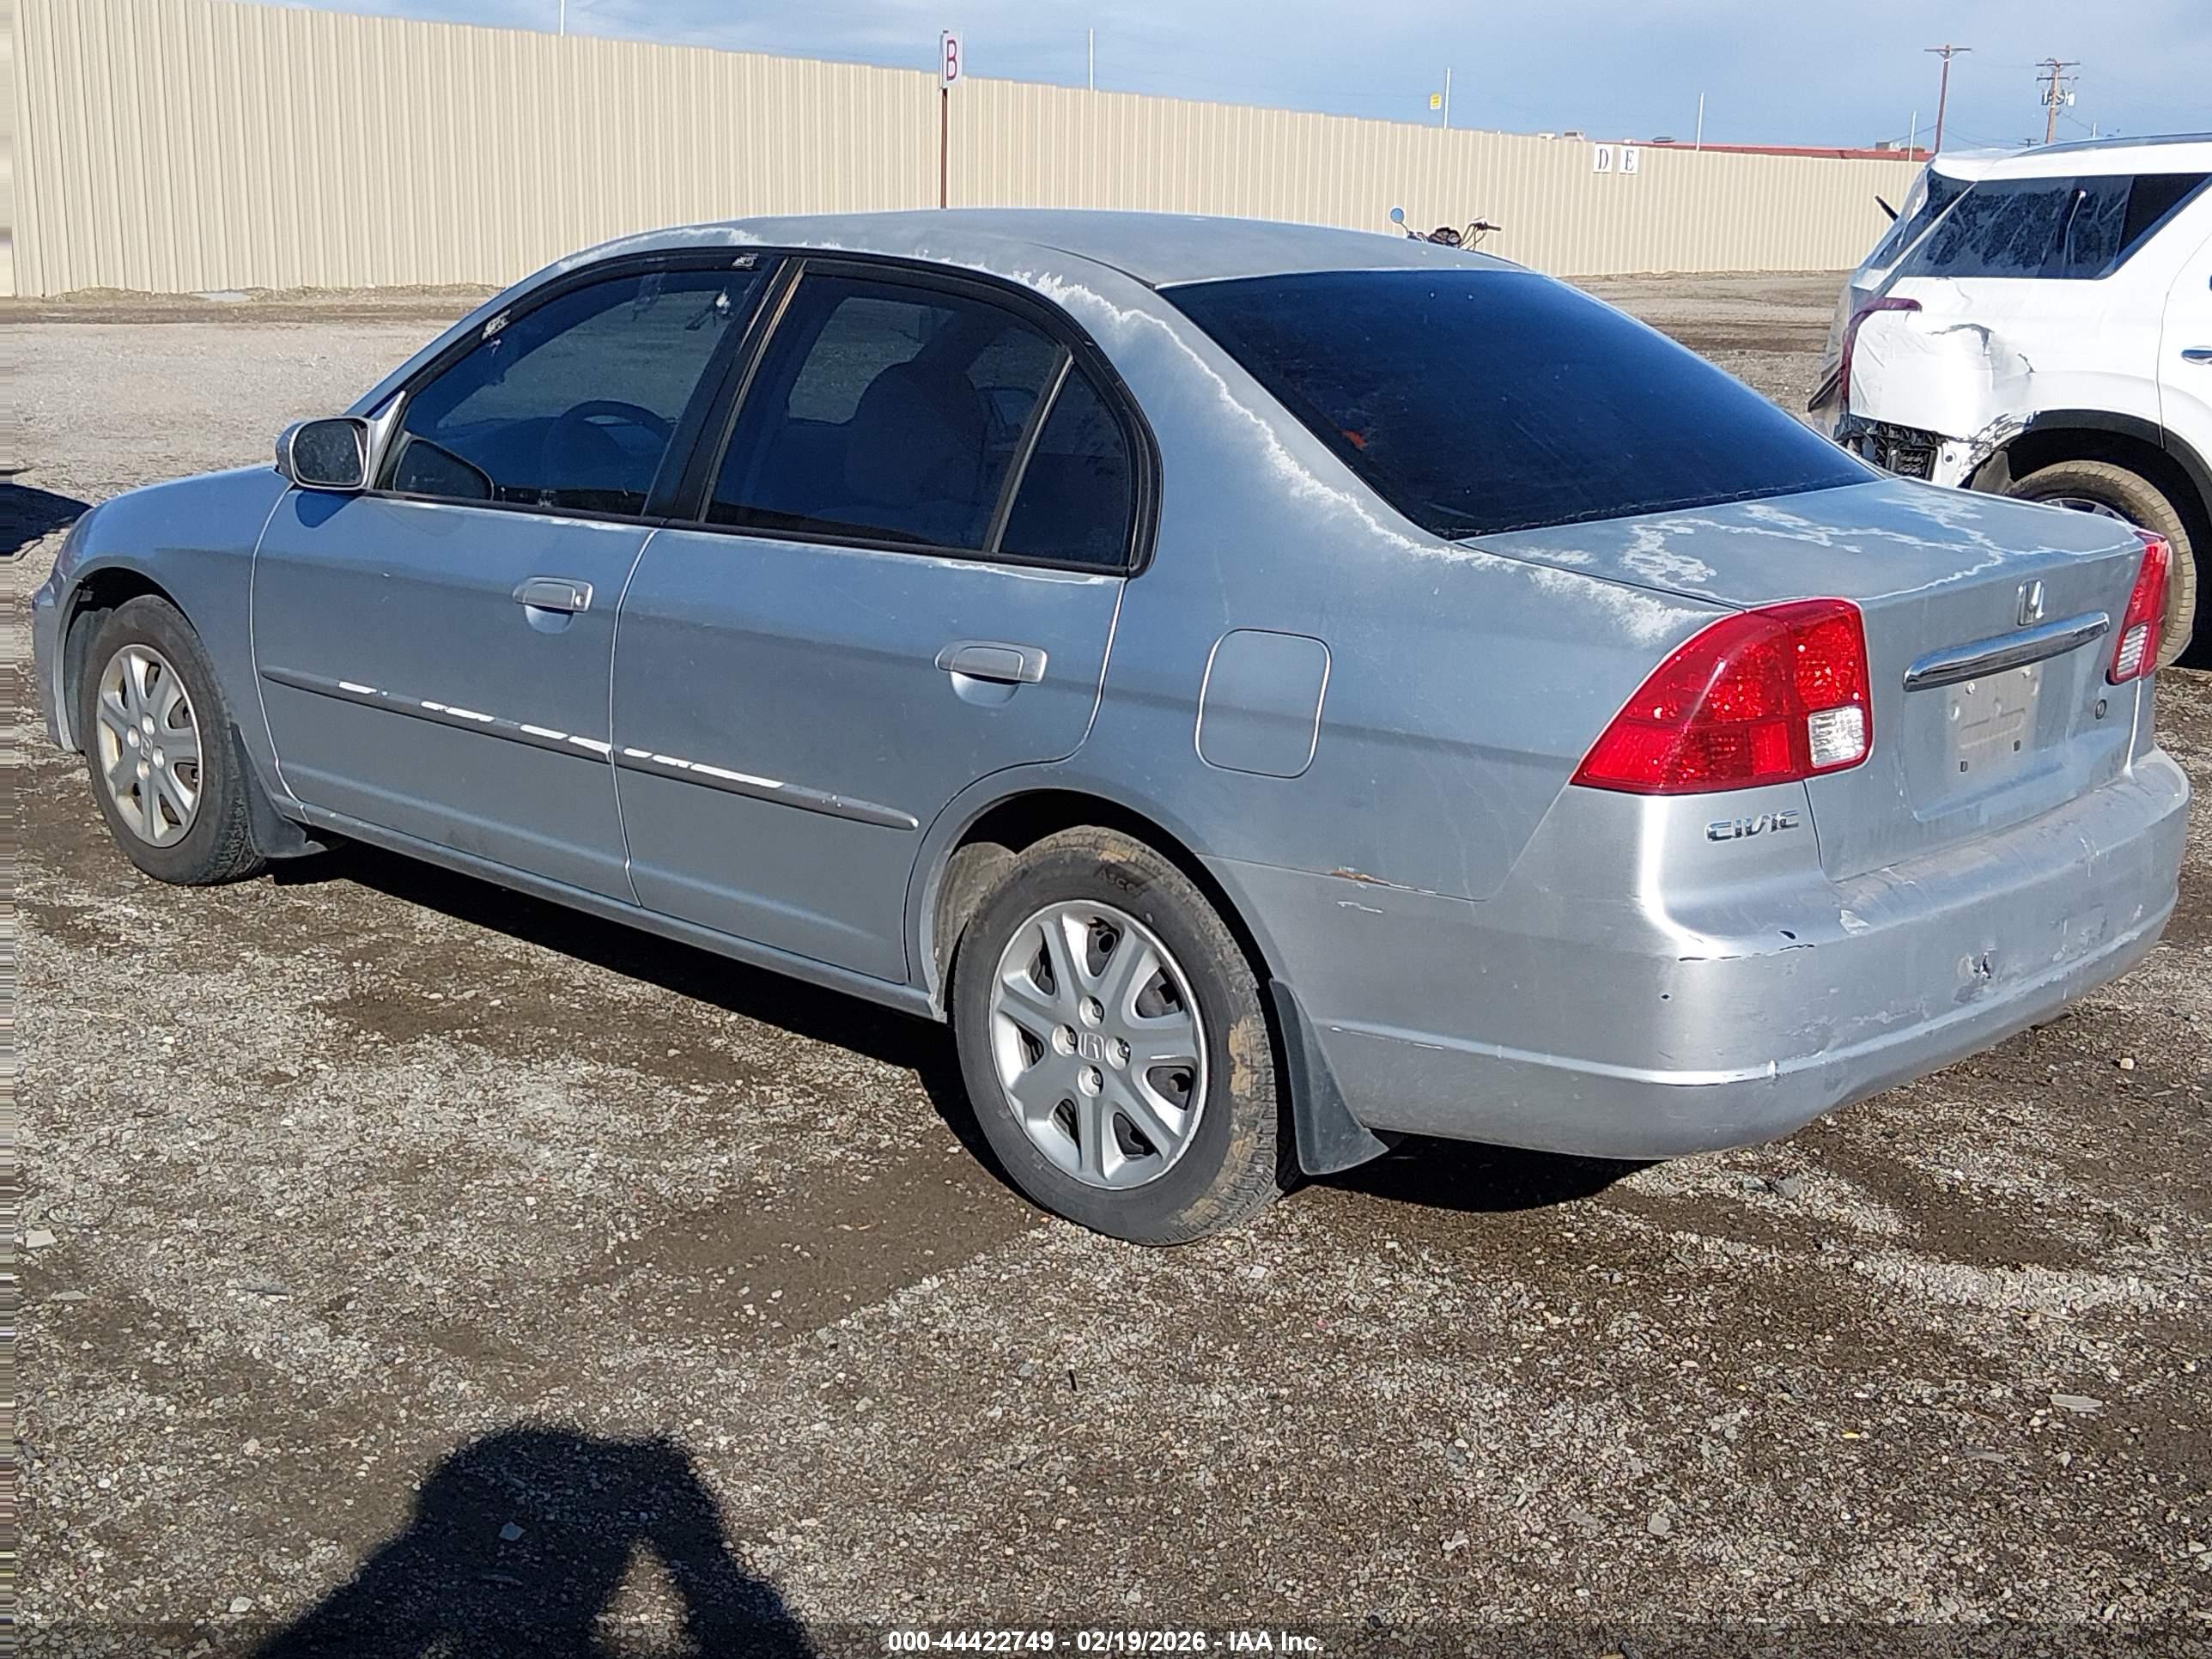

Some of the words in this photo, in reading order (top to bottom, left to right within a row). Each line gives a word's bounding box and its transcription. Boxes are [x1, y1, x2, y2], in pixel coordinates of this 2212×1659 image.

[946, 40, 957, 82] B
[1598, 149, 1609, 170] D
[1625, 149, 1635, 172] E
[1705, 809, 1801, 842] CIVIC
